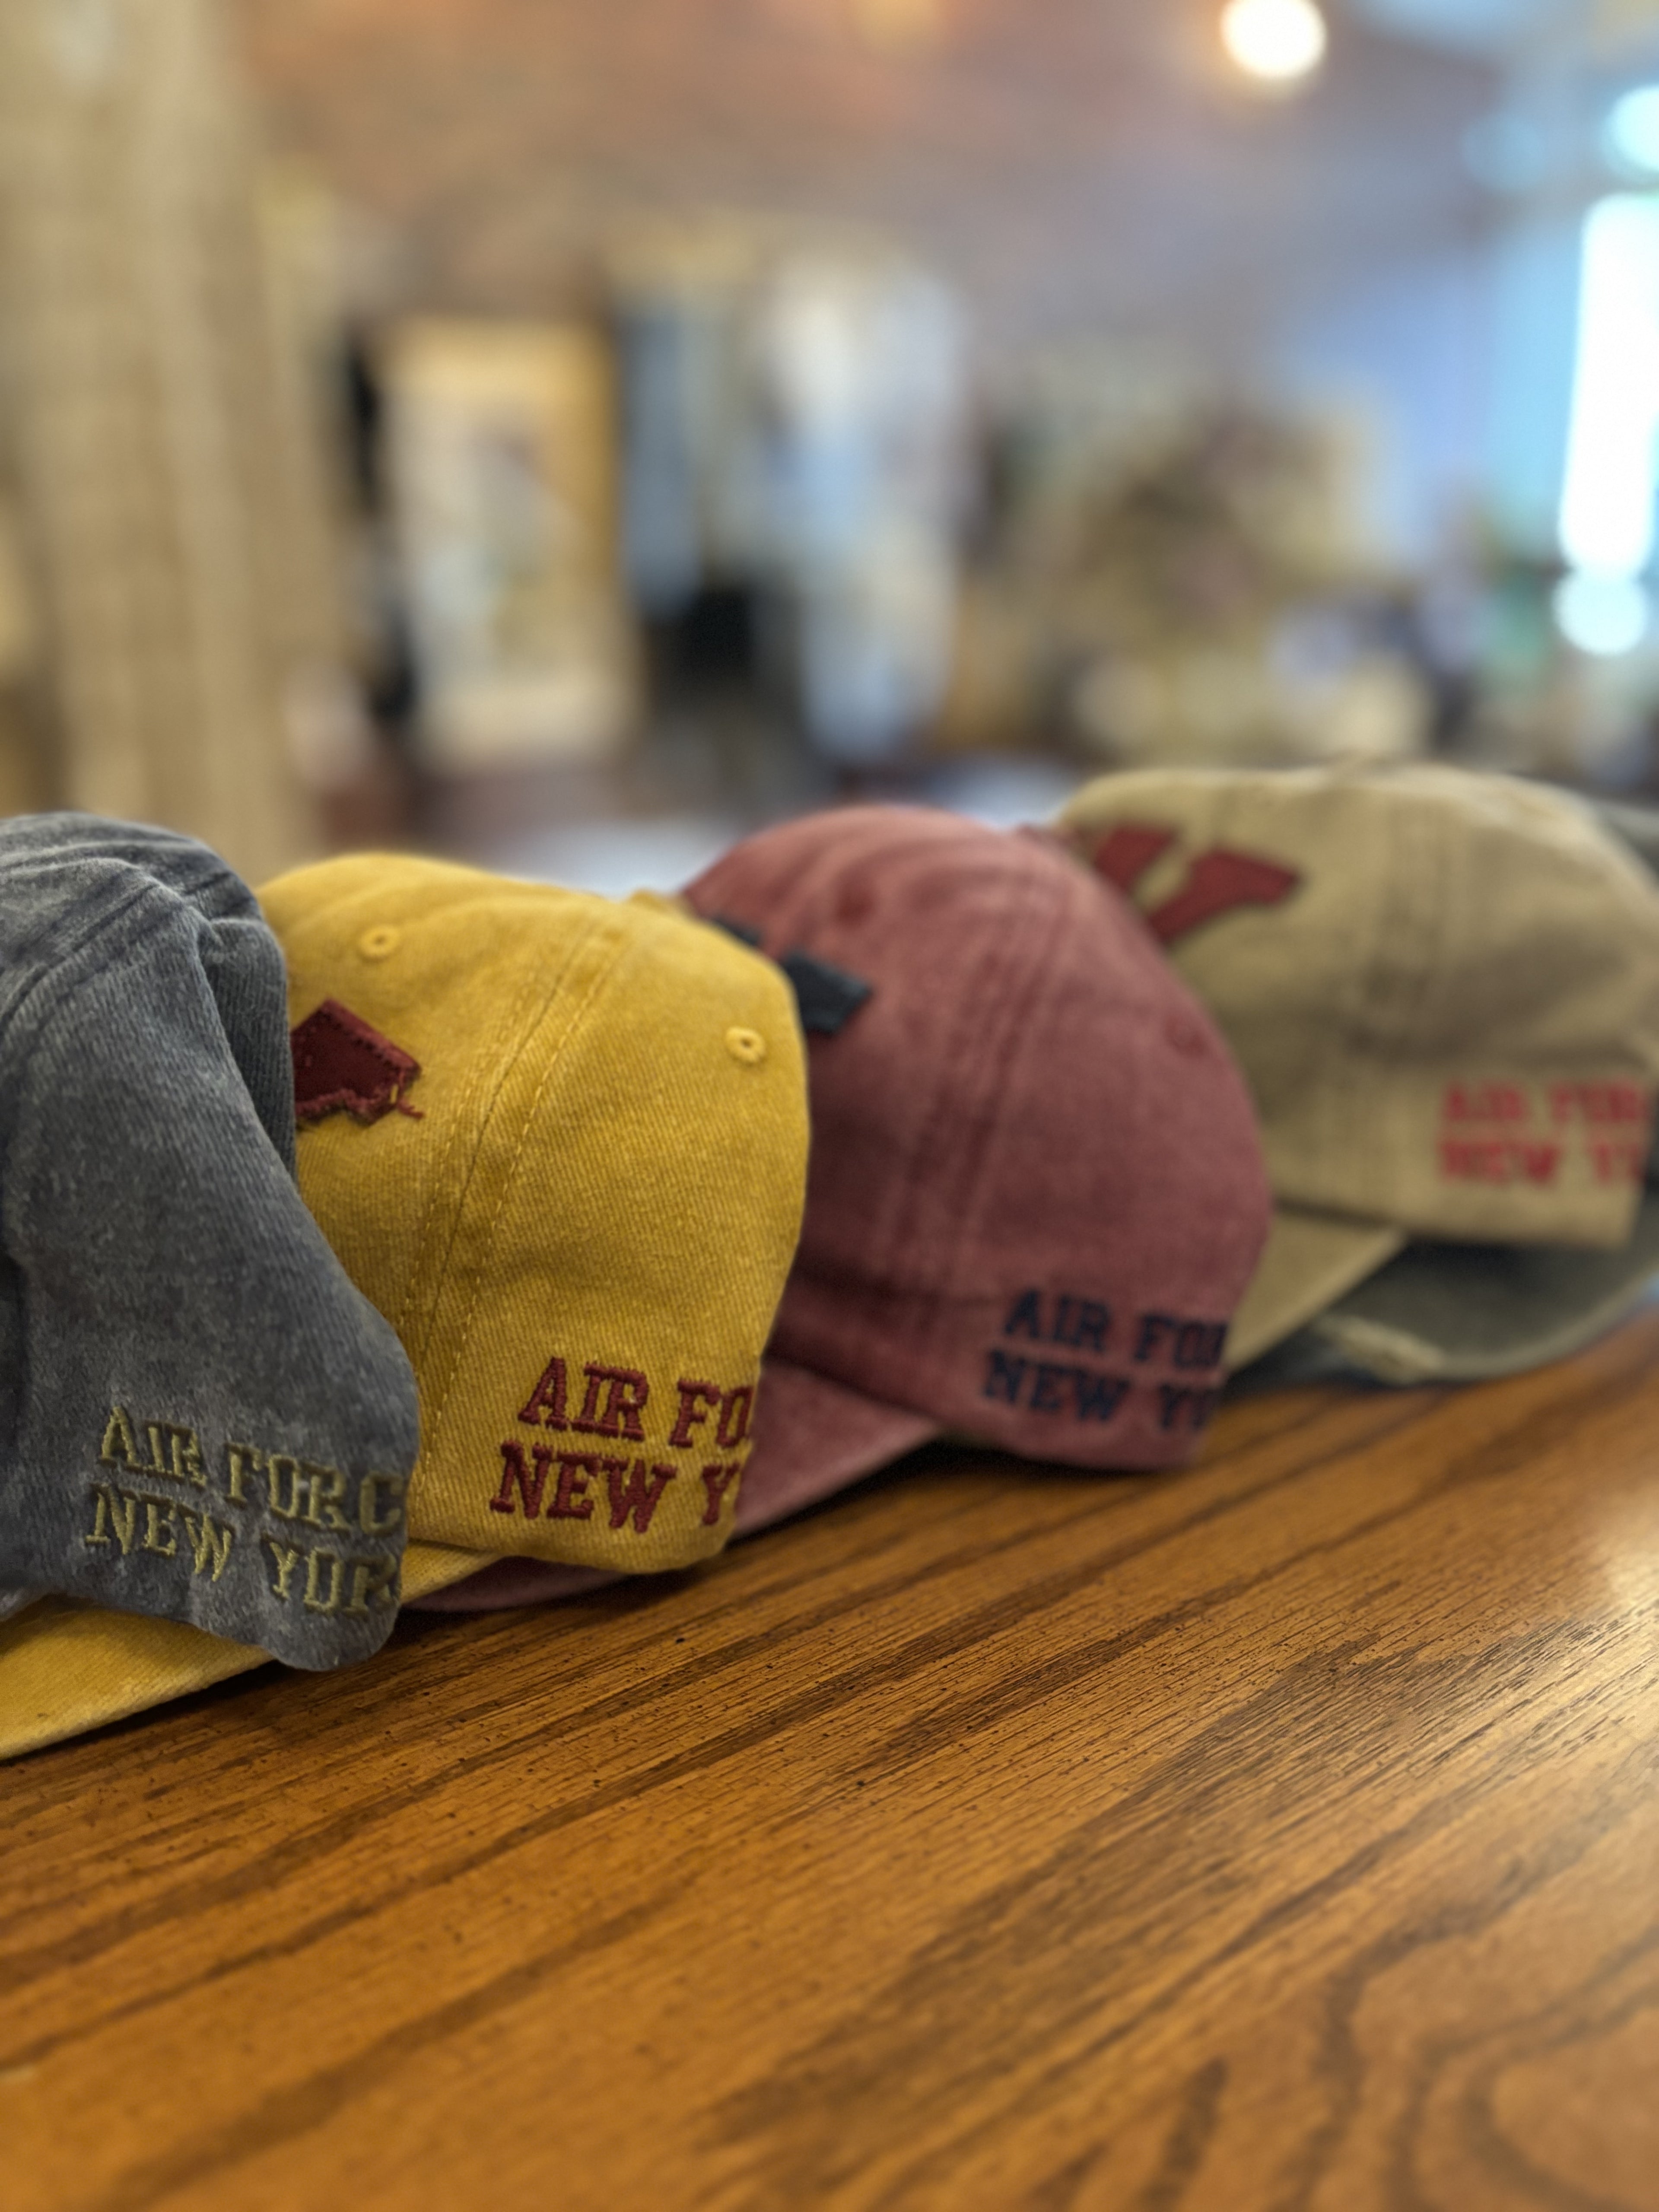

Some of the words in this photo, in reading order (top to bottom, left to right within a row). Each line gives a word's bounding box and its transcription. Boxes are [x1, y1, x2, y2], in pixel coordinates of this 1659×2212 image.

[1002, 1289, 1111, 1353] AIR
[518, 1357, 649, 1442] AIR
[668, 1378, 753, 1448] FO
[983, 1348, 1130, 1422] NEW
[99, 1405, 207, 1490] AIR
[224, 1440, 404, 1538] FORC
[489, 1440, 677, 1534] NEW
[86, 1481, 236, 1582] NEW
